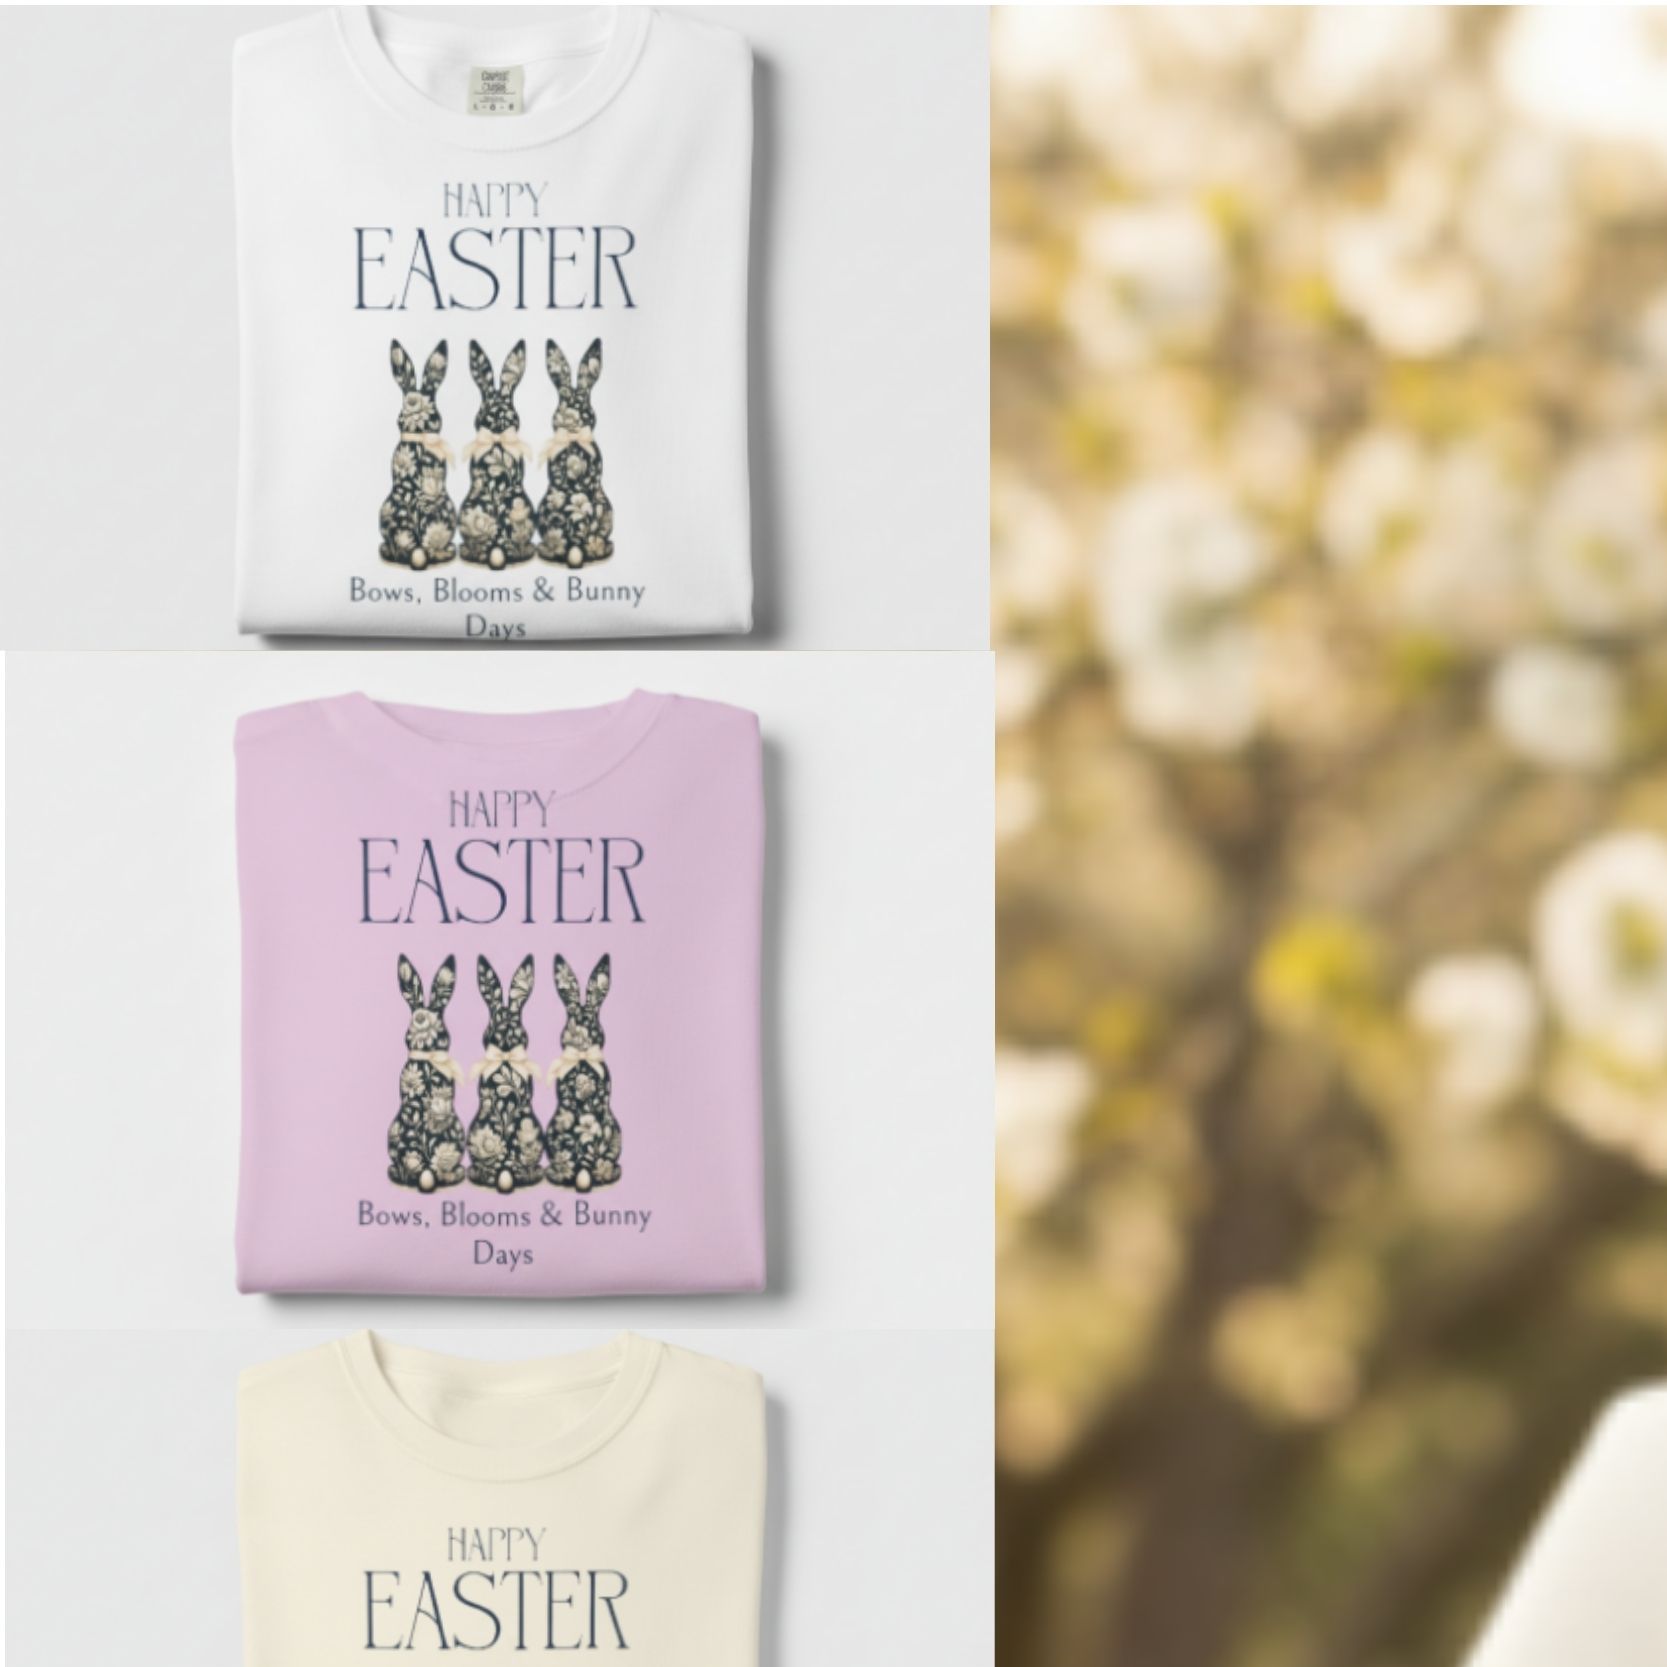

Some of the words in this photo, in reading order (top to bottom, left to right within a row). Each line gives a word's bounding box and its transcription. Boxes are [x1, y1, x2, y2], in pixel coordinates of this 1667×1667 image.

[443, 181, 549, 219] HAPPY
[354, 225, 637, 311] EASTER
[349, 575, 423, 607] Bows,
[433, 576, 524, 604] Blooms
[532, 575, 555, 603] &
[567, 575, 646, 609] Bunny
[465, 613, 527, 641] Days
[449, 789, 556, 829] HAPPY
[359, 837, 646, 925] EASTER
[358, 1199, 431, 1228] Bows,
[440, 1199, 532, 1228] Blooms
[539, 1199, 564, 1227] &
[574, 1199, 652, 1234] Bunny
[473, 1239, 534, 1273] Days
[447, 1526, 545, 1563] HAPPY
[364, 1569, 630, 1651] EASTER
